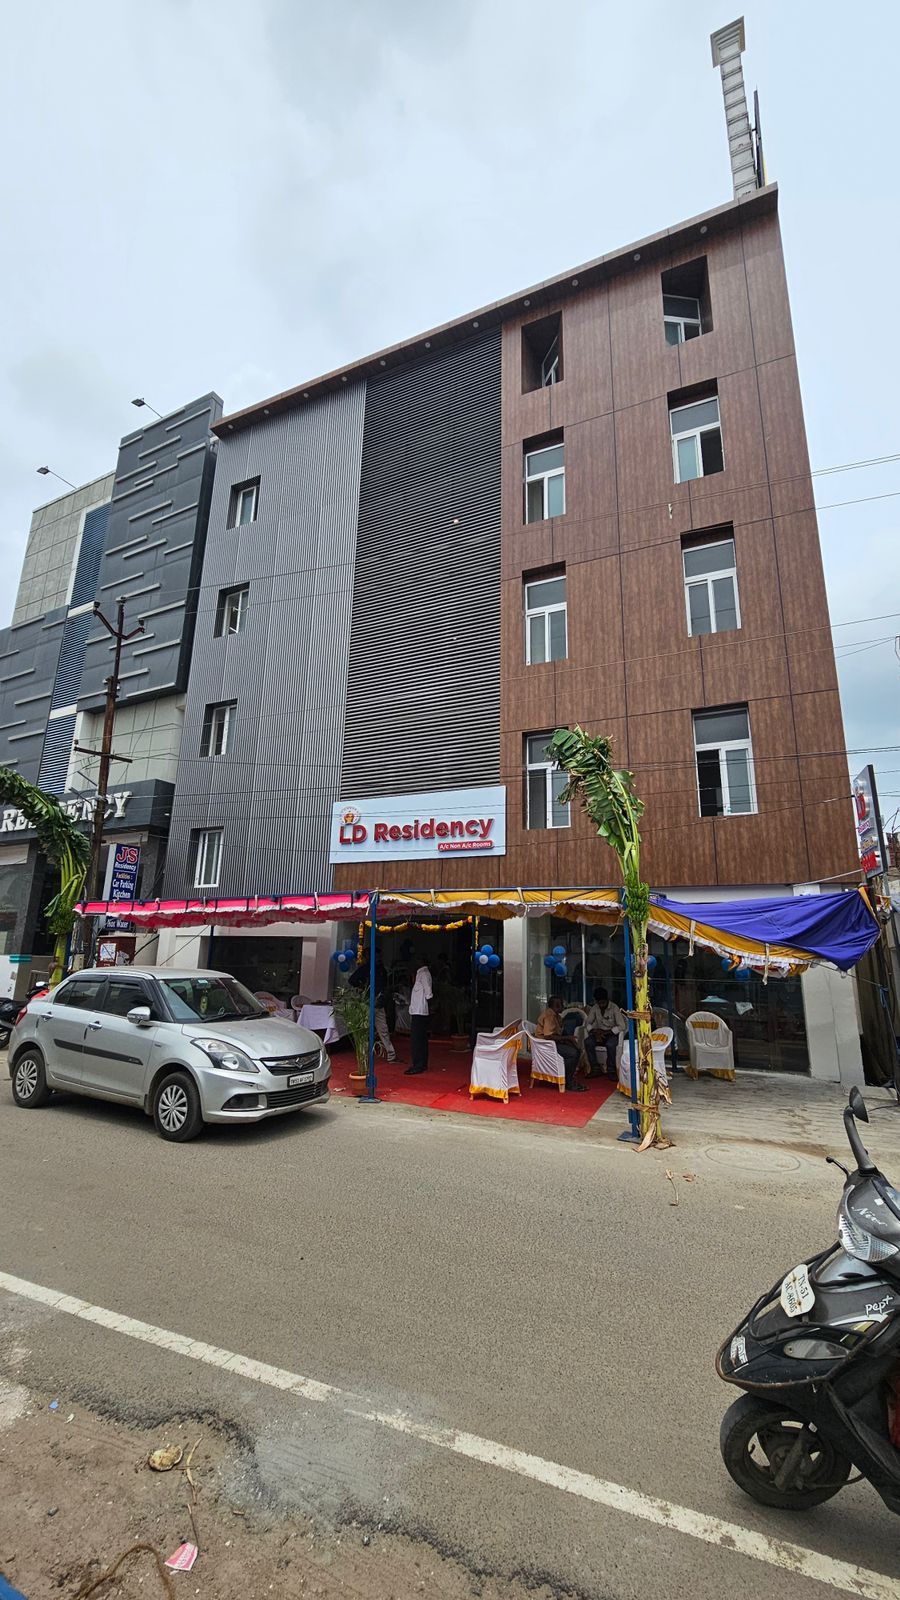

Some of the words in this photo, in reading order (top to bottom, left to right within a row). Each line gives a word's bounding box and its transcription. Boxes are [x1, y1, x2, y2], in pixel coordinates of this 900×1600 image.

[339, 824, 367, 845] LD
[374, 818, 494, 842] Residency
[472, 840, 491, 848] Rooms
[116, 847, 138, 864] JS
[115, 862, 136, 871] Residency
[120, 880, 134, 890] Parking
